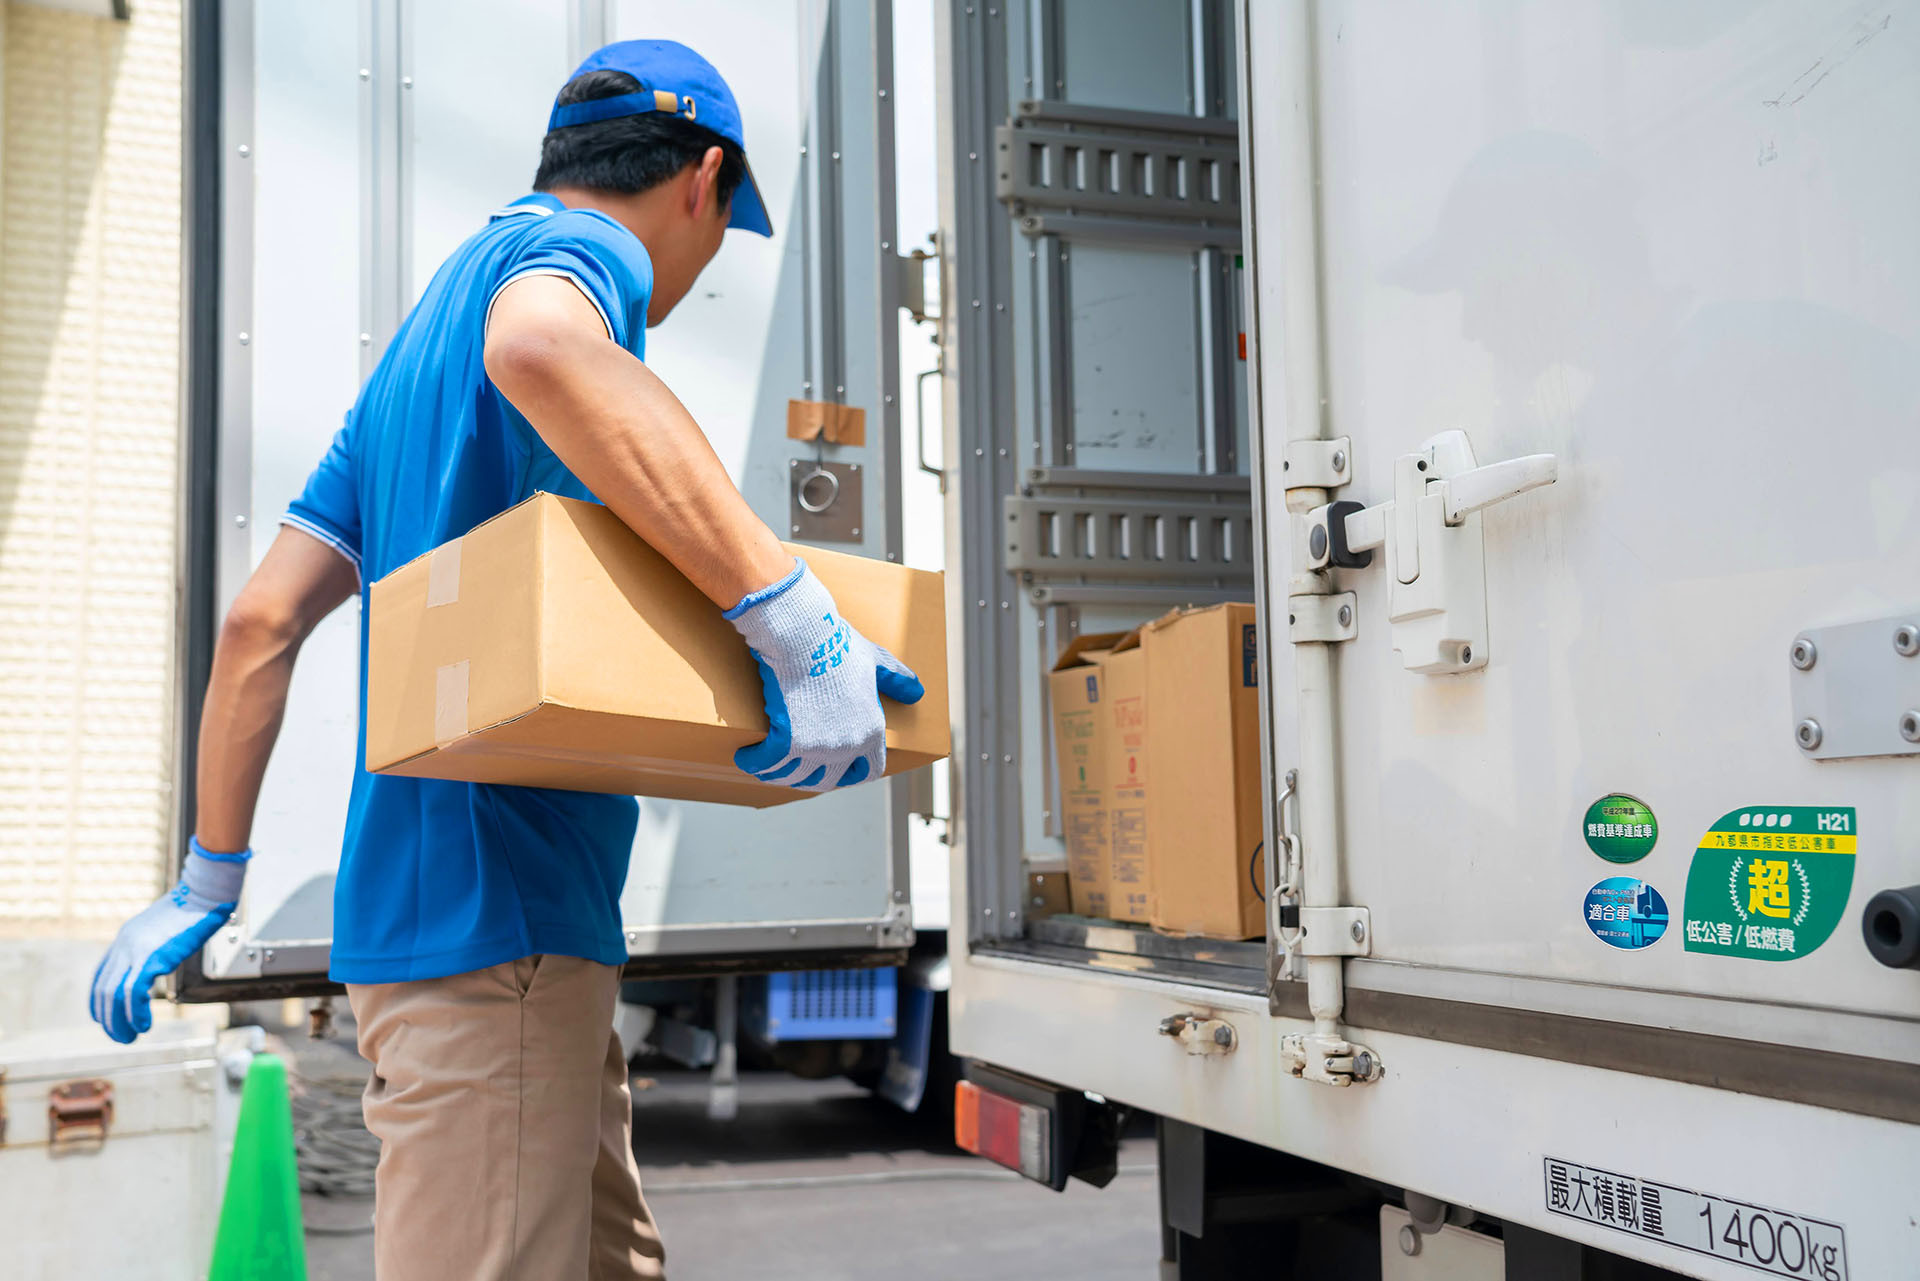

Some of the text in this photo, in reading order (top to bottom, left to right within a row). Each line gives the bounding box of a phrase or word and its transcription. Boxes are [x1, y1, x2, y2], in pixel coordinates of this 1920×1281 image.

[1587, 823, 1653, 838] 燃費基準達成車
[1817, 813, 1850, 832] H21
[1747, 858, 1791, 919] 超
[1588, 903, 1630, 923] 適合車
[1549, 1164, 1841, 1281] 最大積載量 1400kg
